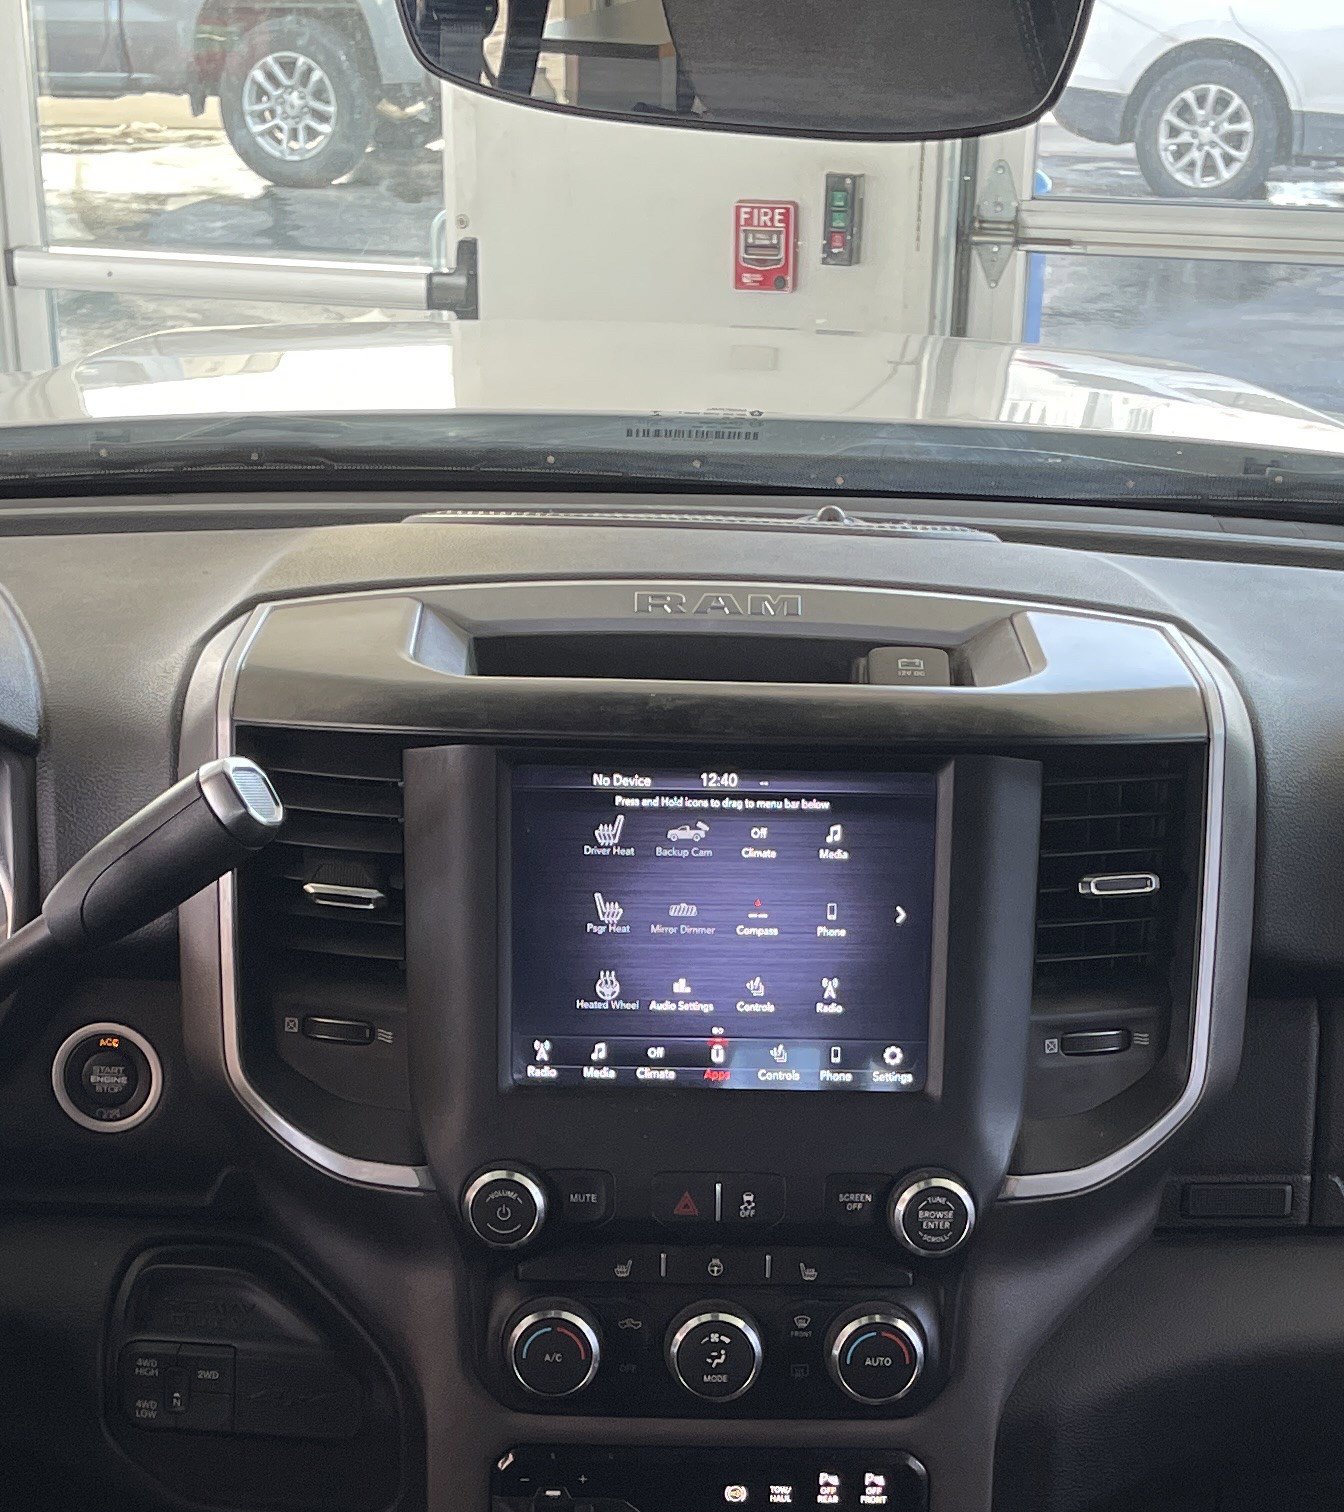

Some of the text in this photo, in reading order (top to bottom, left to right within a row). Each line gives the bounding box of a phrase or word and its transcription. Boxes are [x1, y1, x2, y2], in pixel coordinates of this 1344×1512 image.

[739, 207, 786, 227] FIRE
[634, 591, 801, 616] RAM
[593, 773, 652, 787] No Device
[700, 772, 738, 787] 12:40
[615, 795, 830, 811] Press and Hold icons to drag to menu bar below
[750, 827, 768, 839] Off
[583, 845, 635, 857] Driver Heat
[656, 847, 713, 859] Backup Cam
[741, 847, 777, 859] Climate
[818, 848, 849, 860] Media
[586, 922, 631, 935] Psgr Heat
[650, 924, 716, 935] Mirror Dimmer
[735, 925, 779, 938] Compass
[816, 925, 847, 937] Phone
[576, 1000, 640, 1010] Heated Wheel
[649, 1000, 714, 1013] Audio Settings
[736, 1001, 775, 1012] Controls
[816, 1002, 844, 1013] Radio
[99, 1038, 119, 1048] ACC
[647, 1047, 665, 1059] Off
[92, 1066, 125, 1075] START
[526, 1065, 558, 1078] Radio
[583, 1066, 616, 1079] Media
[636, 1067, 676, 1080] Climate
[704, 1069, 731, 1082] Apps
[757, 1069, 800, 1081] Controls
[819, 1070, 853, 1082] Phone
[90, 1075, 128, 1085] ENGINE
[872, 1071, 913, 1084] Settings
[489, 1189, 518, 1199] VOLUME
[569, 1193, 597, 1203] MUTE
[838, 1193, 872, 1203] SCREEN
[846, 1202, 862, 1211] OFF
[739, 1209, 756, 1218] OFF
[918, 1210, 954, 1219] BROWSE
[922, 1220, 951, 1230] ENTER
[922, 1233, 949, 1243] SCROLL
[136, 1357, 157, 1367] 4WD
[544, 1352, 563, 1363] A/C
[864, 1357, 892, 1367] AUTO
[197, 1370, 219, 1380] 2WD
[703, 1374, 728, 1383] MODE
[136, 1399, 157, 1409] 4WD
[136, 1409, 156, 1418] LOW
[819, 1486, 836, 1495] OFF
[865, 1486, 883, 1495] OFF
[860, 1495, 888, 1504] FRONT
